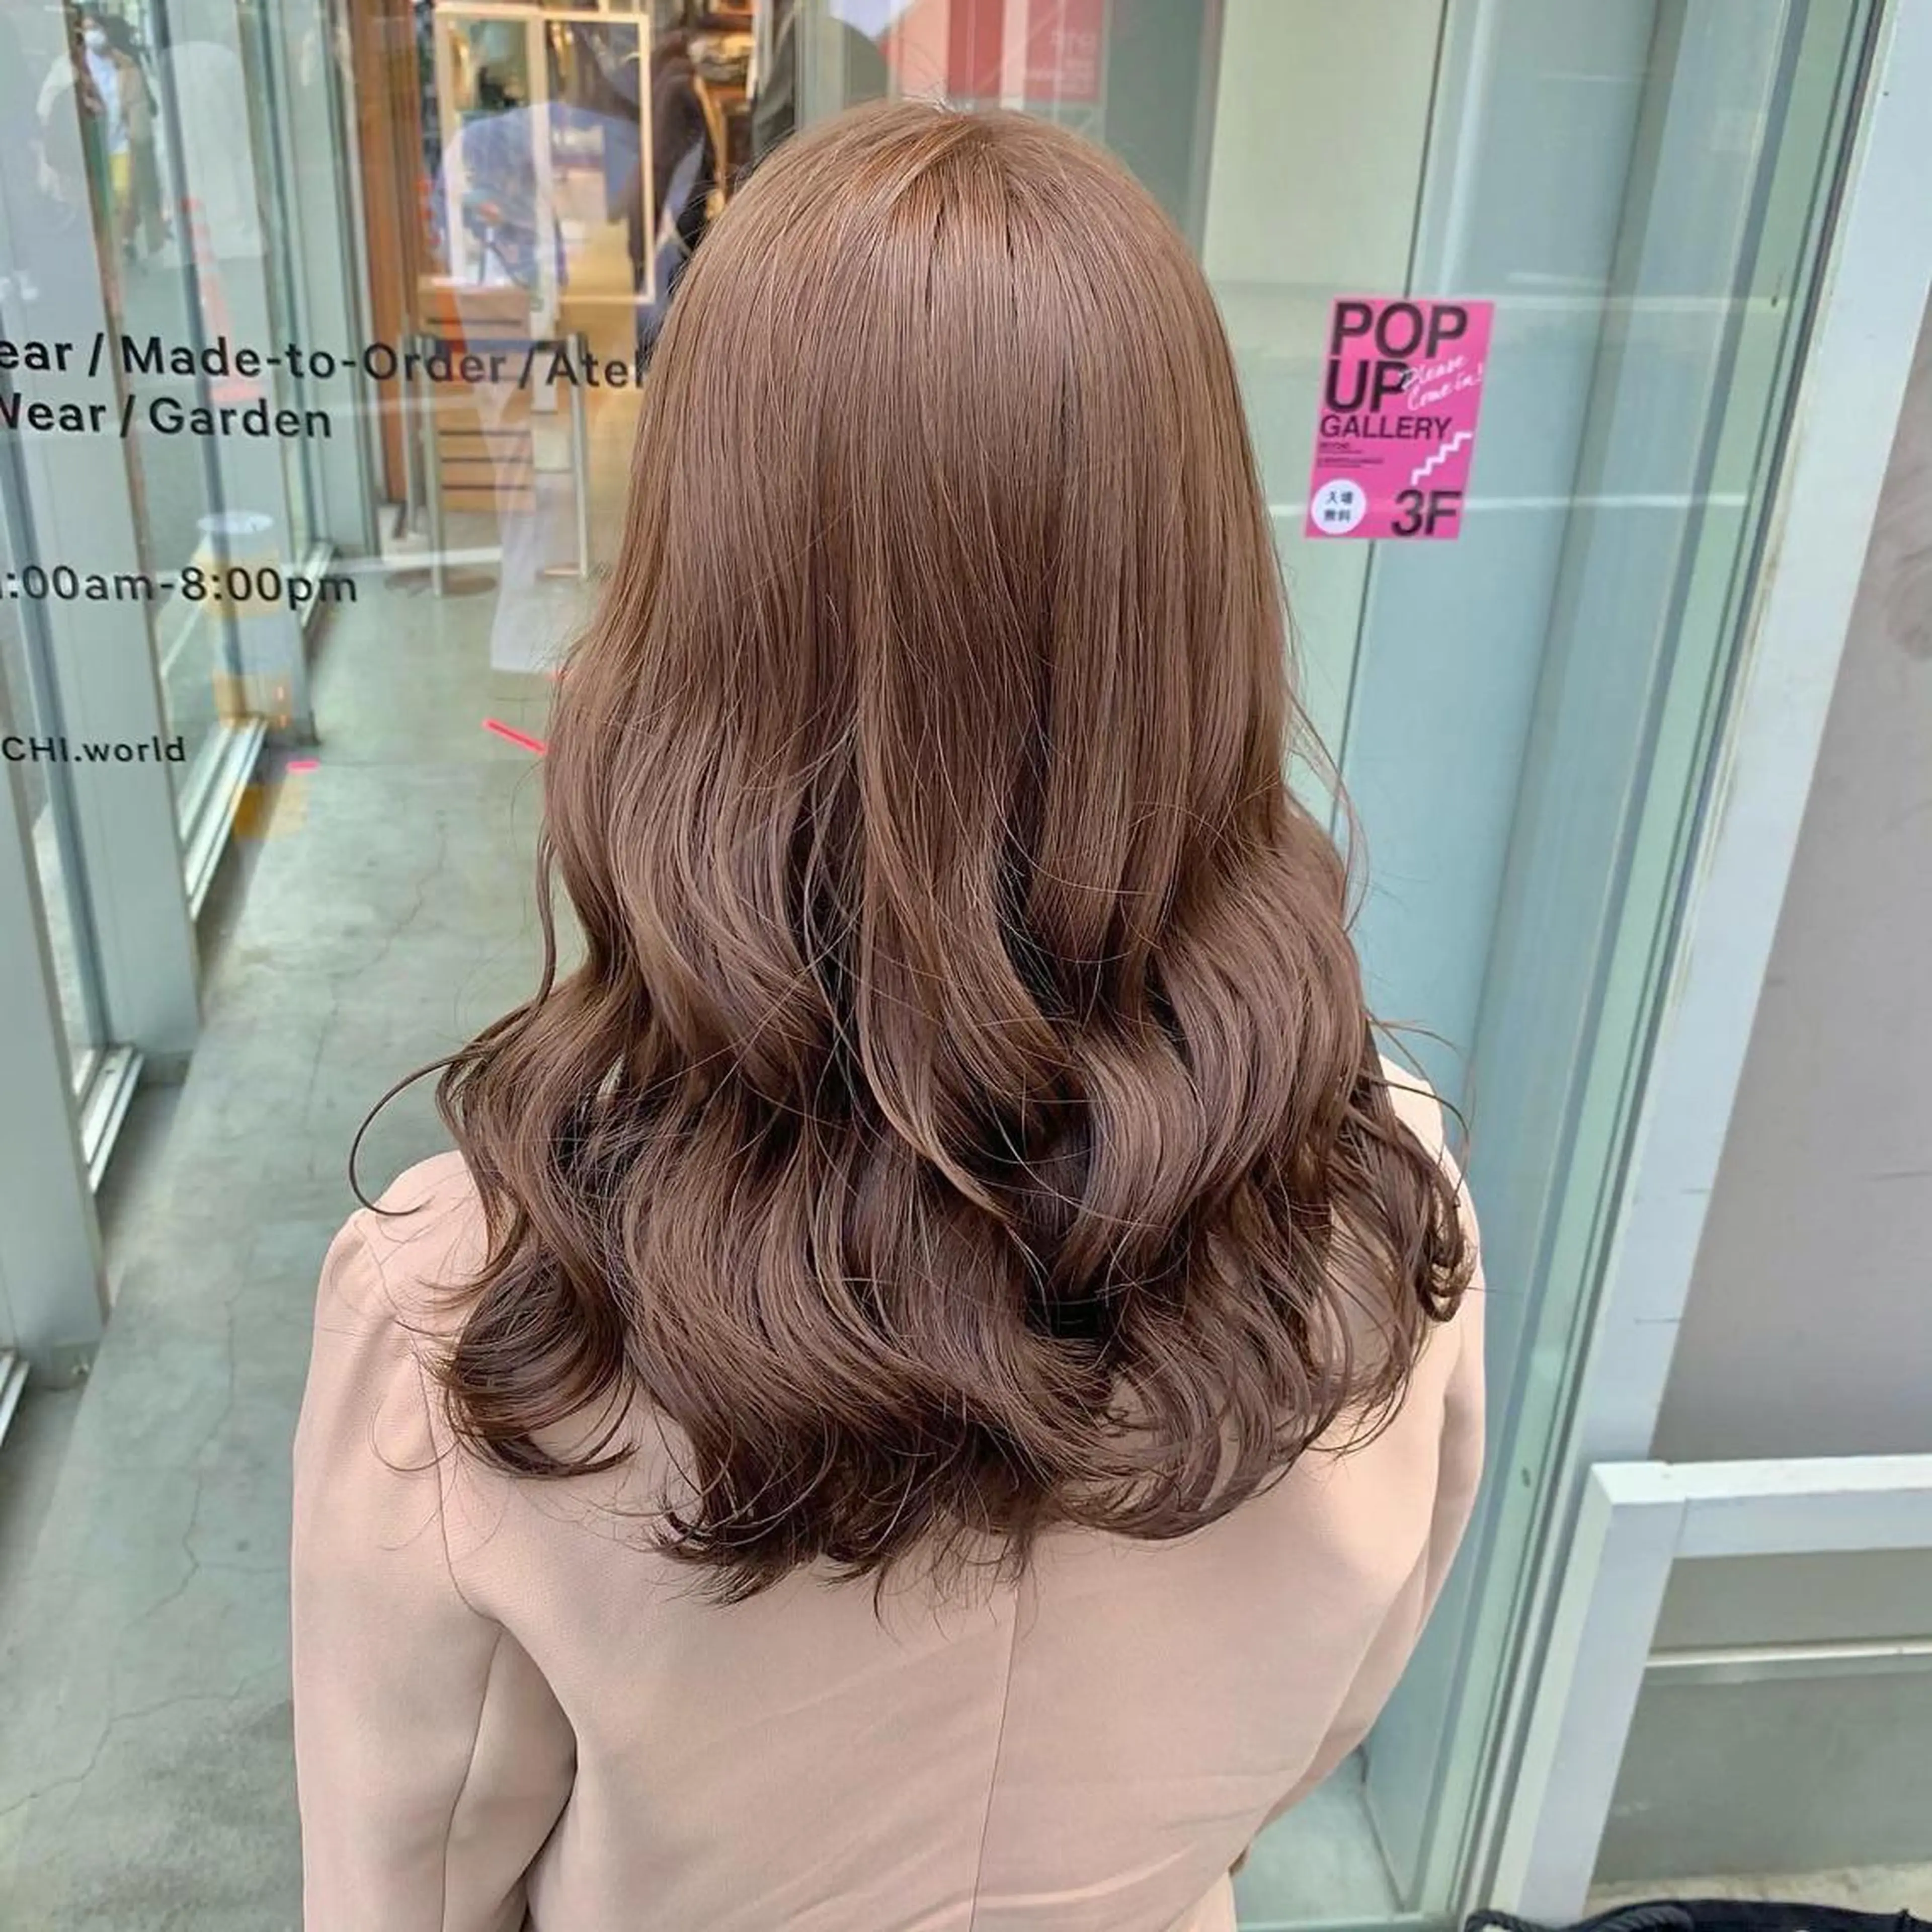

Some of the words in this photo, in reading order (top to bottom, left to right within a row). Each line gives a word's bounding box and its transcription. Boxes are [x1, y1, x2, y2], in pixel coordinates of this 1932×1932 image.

[1330, 301, 1468, 359] POP
[121, 336, 506, 384] Made-to-Order
[1325, 359, 1412, 413] UP
[149, 397, 332, 439] Garden
[1319, 415, 1453, 440] GALLERY
[1391, 489, 1463, 537] 3F
[0, 564, 358, 610] :00am-8:00pm
